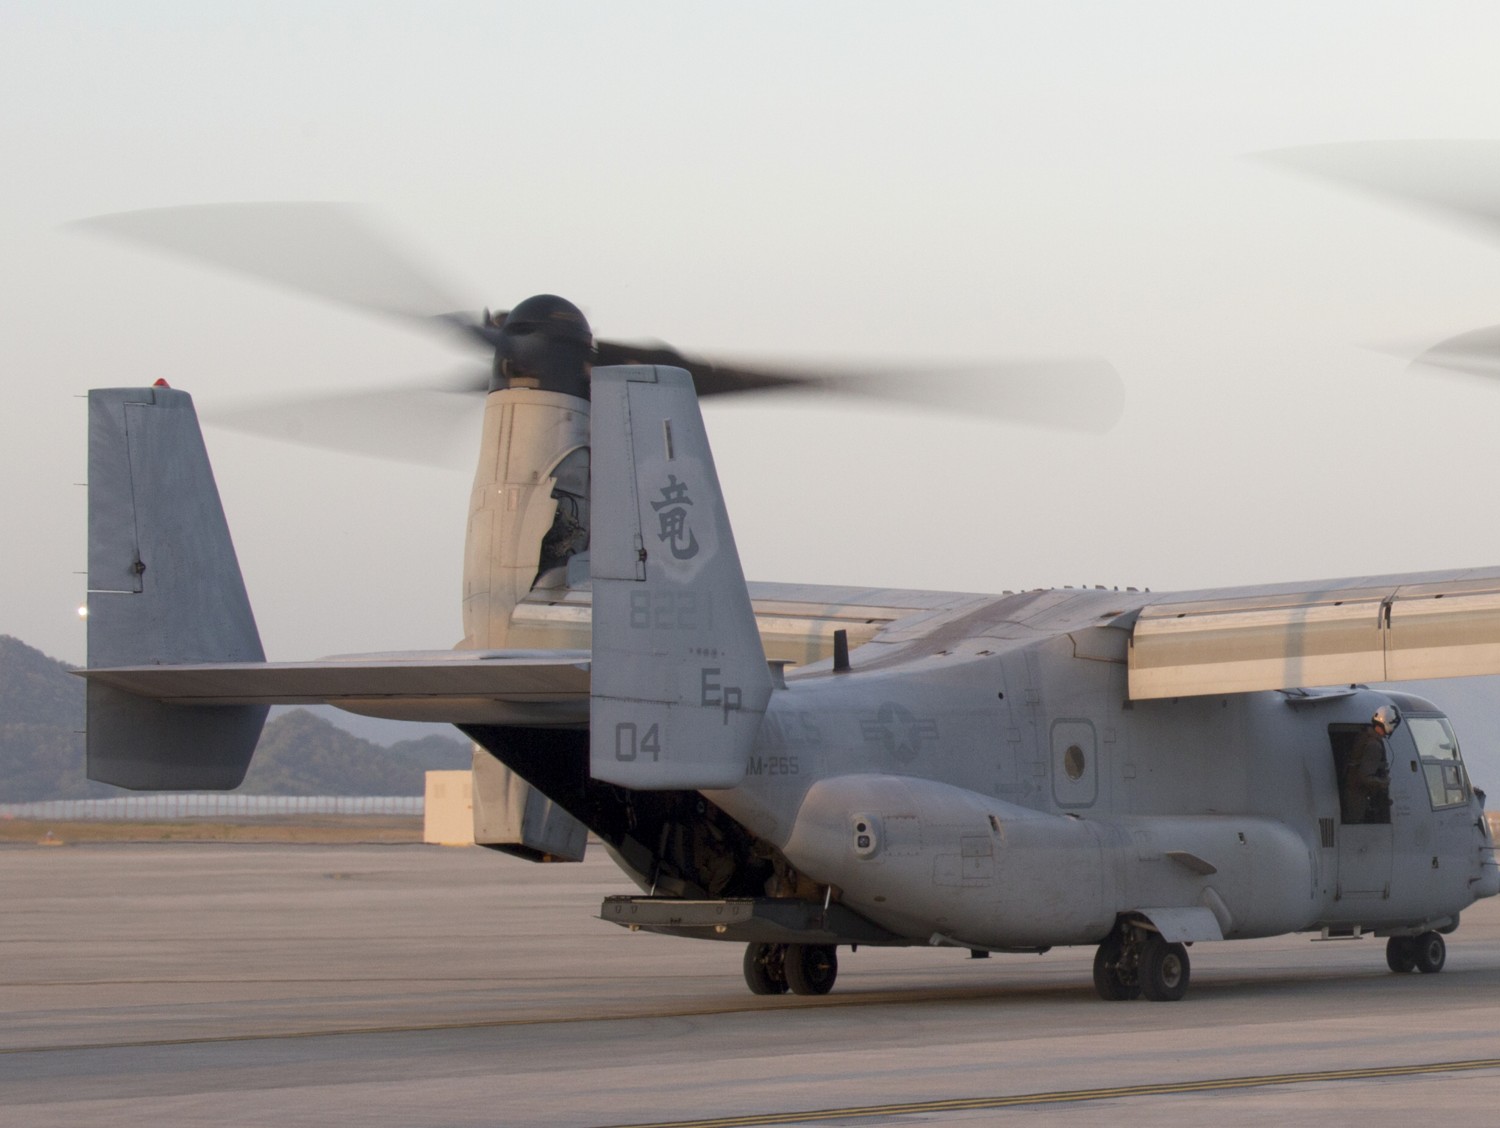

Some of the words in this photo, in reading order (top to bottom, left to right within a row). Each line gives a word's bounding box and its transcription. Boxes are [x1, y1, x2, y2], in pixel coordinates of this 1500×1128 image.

[650, 473, 700, 561] 竜
[629, 590, 714, 631] 8221
[615, 722, 662, 762] 04
